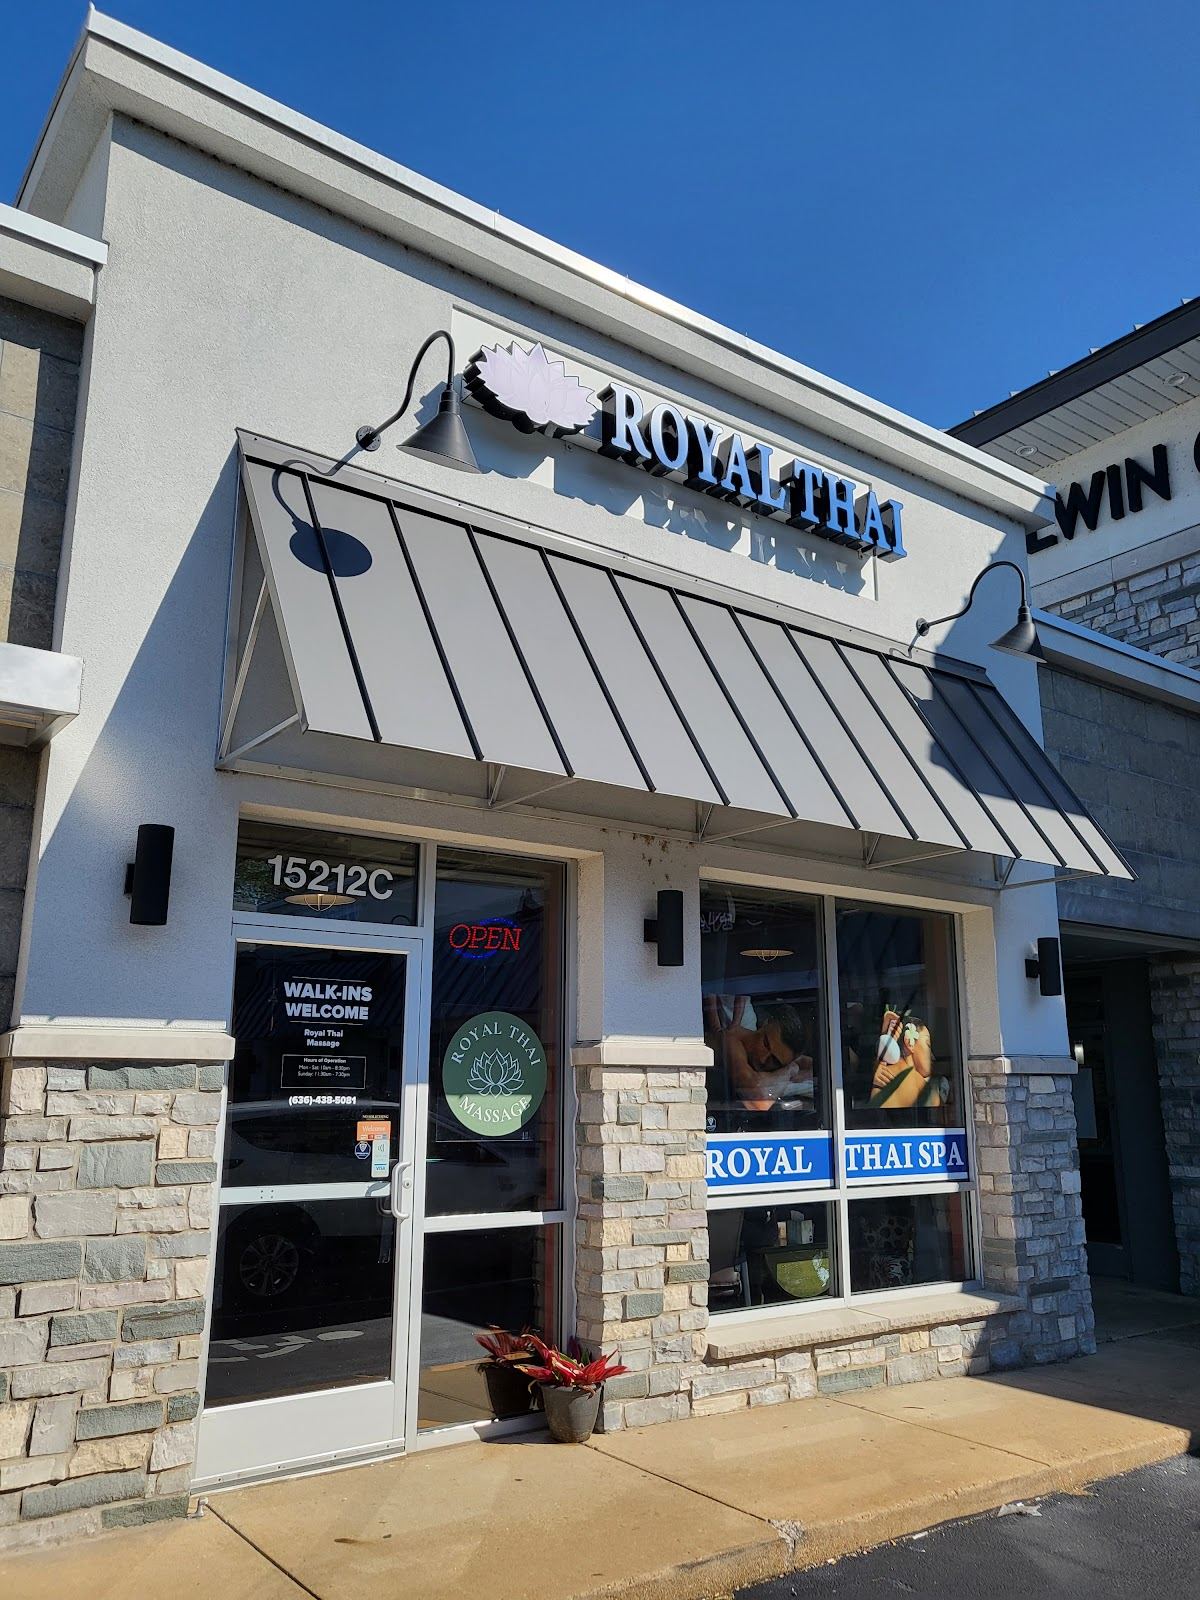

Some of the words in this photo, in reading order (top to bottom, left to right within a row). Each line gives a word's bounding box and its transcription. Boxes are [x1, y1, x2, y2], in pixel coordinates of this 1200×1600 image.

[609, 382, 788, 508] ROYAL
[793, 458, 907, 557] THAI
[267, 854, 394, 900] 15212C
[449, 923, 522, 951] OPEN
[284, 981, 372, 1002] WALK-INS
[285, 1002, 369, 1020] WELCOME
[304, 1028, 325, 1038] Royal
[326, 1029, 344, 1037] Thai
[306, 1038, 340, 1049] Massage
[450, 1021, 502, 1065] ROYAL
[509, 1024, 541, 1066] THAI
[459, 1095, 531, 1123] MASSAGE
[704, 1146, 813, 1179] ROYAL
[846, 1142, 914, 1172] THAI
[918, 1140, 965, 1168] SPA
